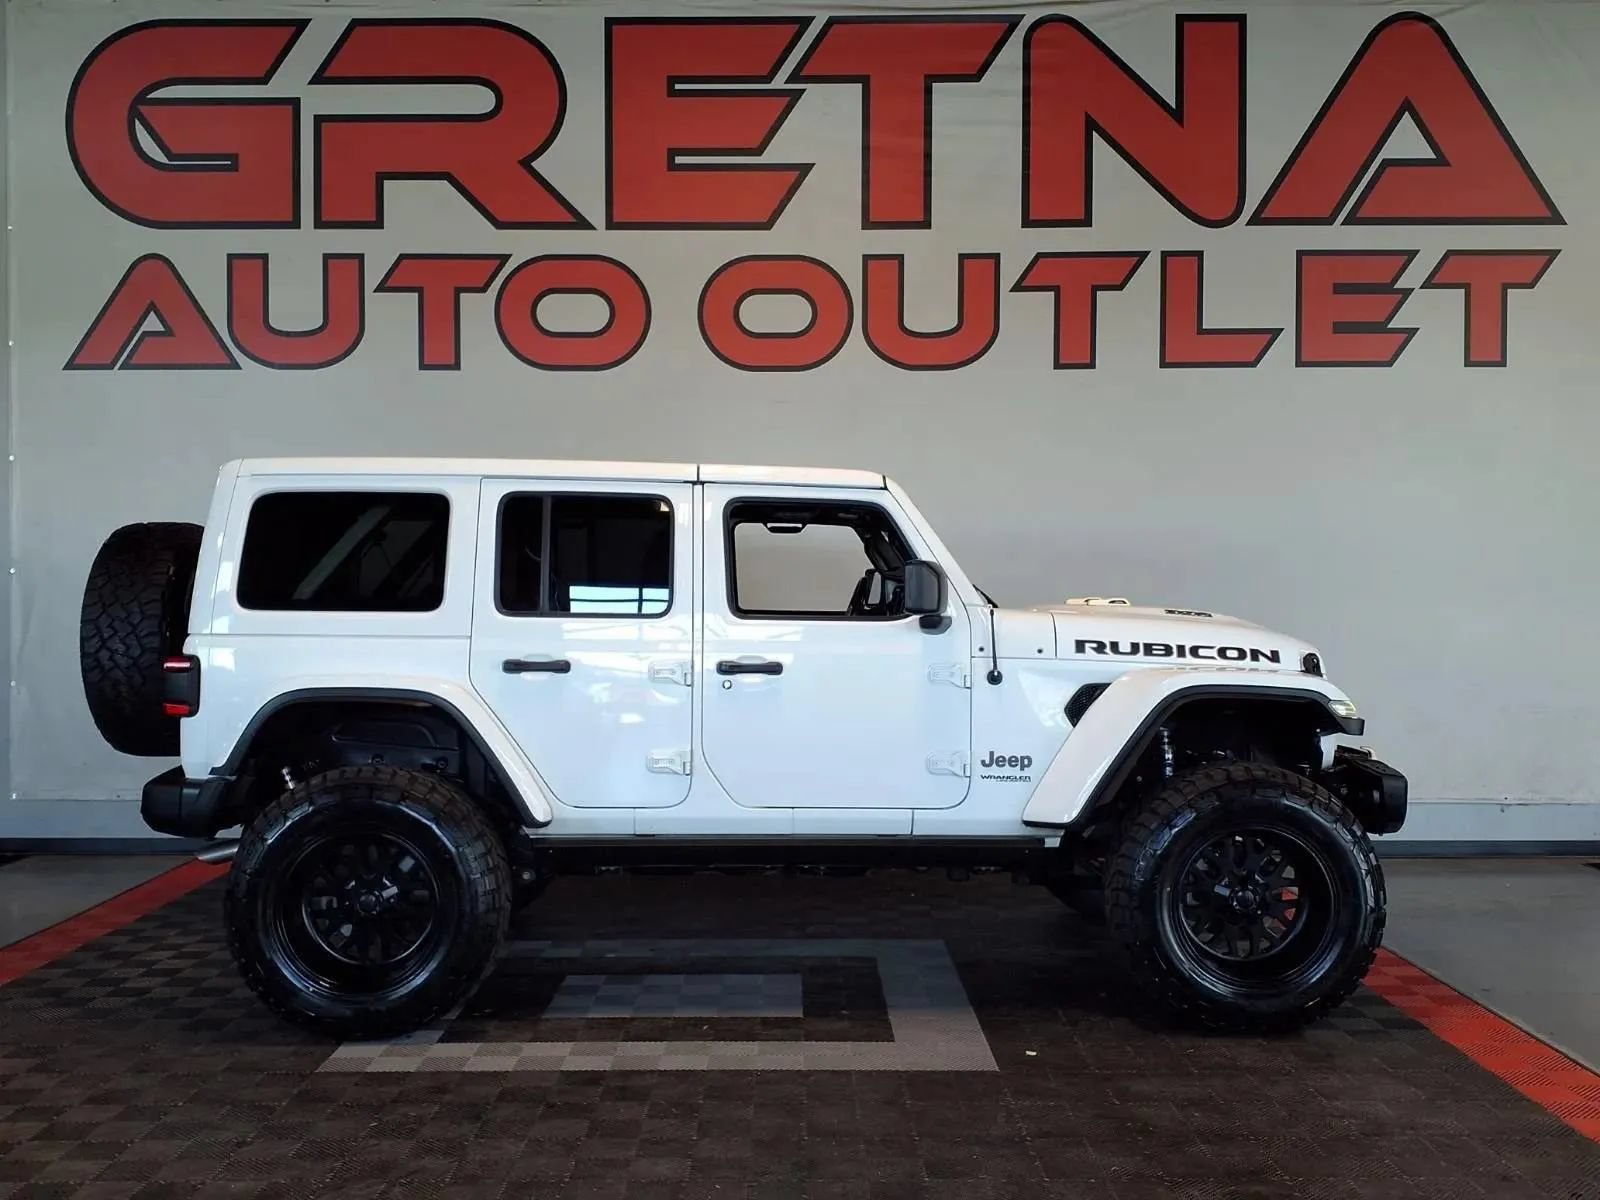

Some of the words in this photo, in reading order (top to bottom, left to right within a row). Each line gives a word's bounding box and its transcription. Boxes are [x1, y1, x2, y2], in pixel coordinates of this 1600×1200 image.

[66, 11, 1568, 230] GRETNA
[62, 252, 652, 372] AUTO
[697, 248, 1562, 372] OUTLET
[1074, 639, 1281, 664] RUBICON
[980, 750, 1033, 771] Jeep
